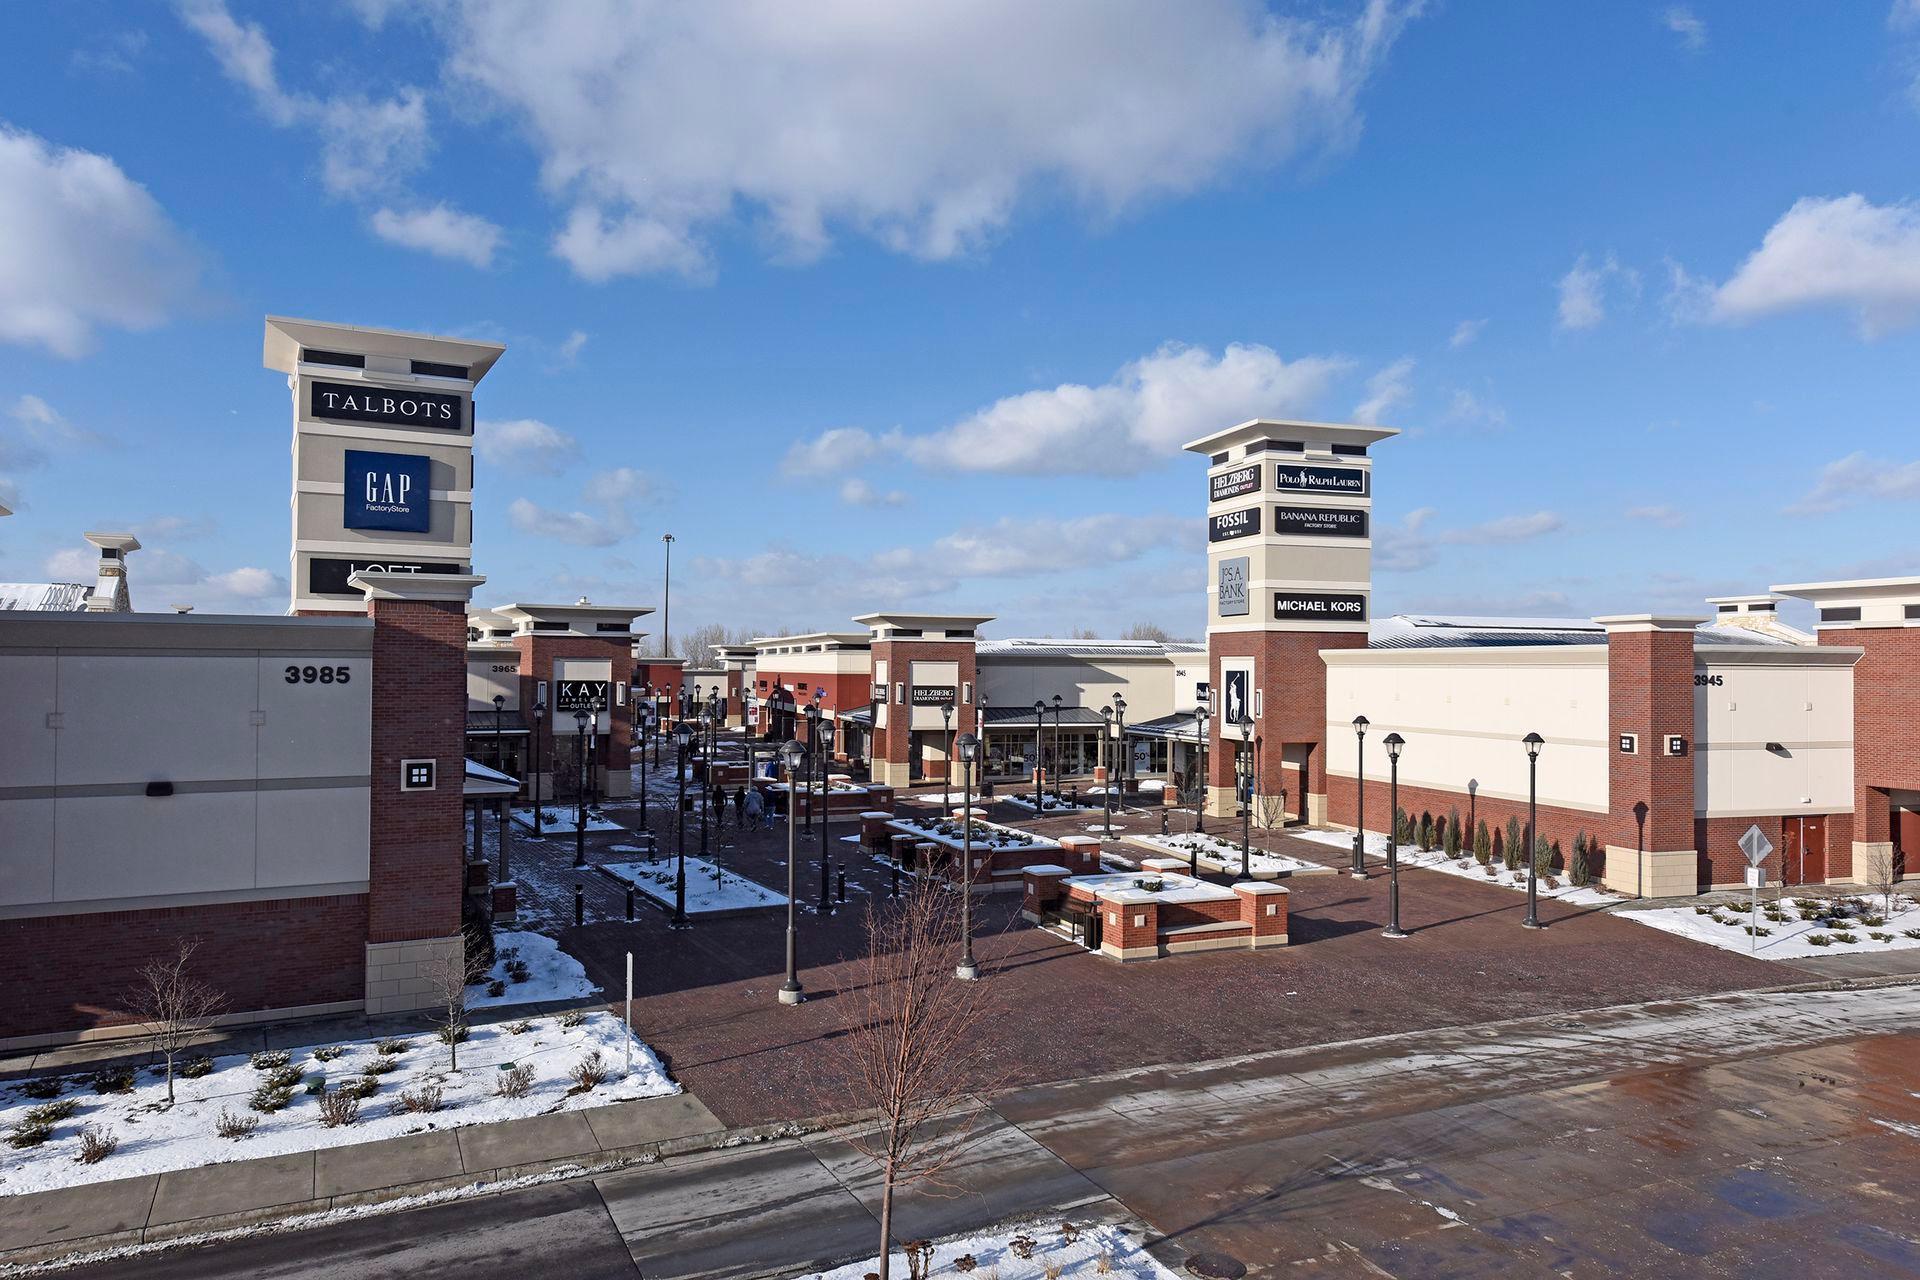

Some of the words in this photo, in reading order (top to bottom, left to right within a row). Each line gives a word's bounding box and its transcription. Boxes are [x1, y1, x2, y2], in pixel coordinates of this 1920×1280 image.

[322, 392, 452, 419] TALBOTS
[1214, 468, 1255, 490] HELZBERG
[1308, 474, 1332, 486] RALPH
[1333, 476, 1361, 487] LAUREN
[366, 471, 410, 504] GAP
[1213, 484, 1240, 499] DIAMONDS
[366, 504, 410, 513] FactoryStore
[1217, 510, 1249, 529] FOSSIL
[1280, 511, 1318, 521] BANANA
[1319, 513, 1360, 523] REPUBLIC
[1219, 582, 1245, 600] BANK
[1277, 600, 1327, 611] MICHAEL
[1331, 601, 1361, 612] KORS
[285, 666, 350, 684] 3985
[492, 665, 516, 673] 3965
[1694, 675, 1723, 686] 3945
[562, 683, 606, 696] KAY
[914, 689, 954, 697] HELZBERG
